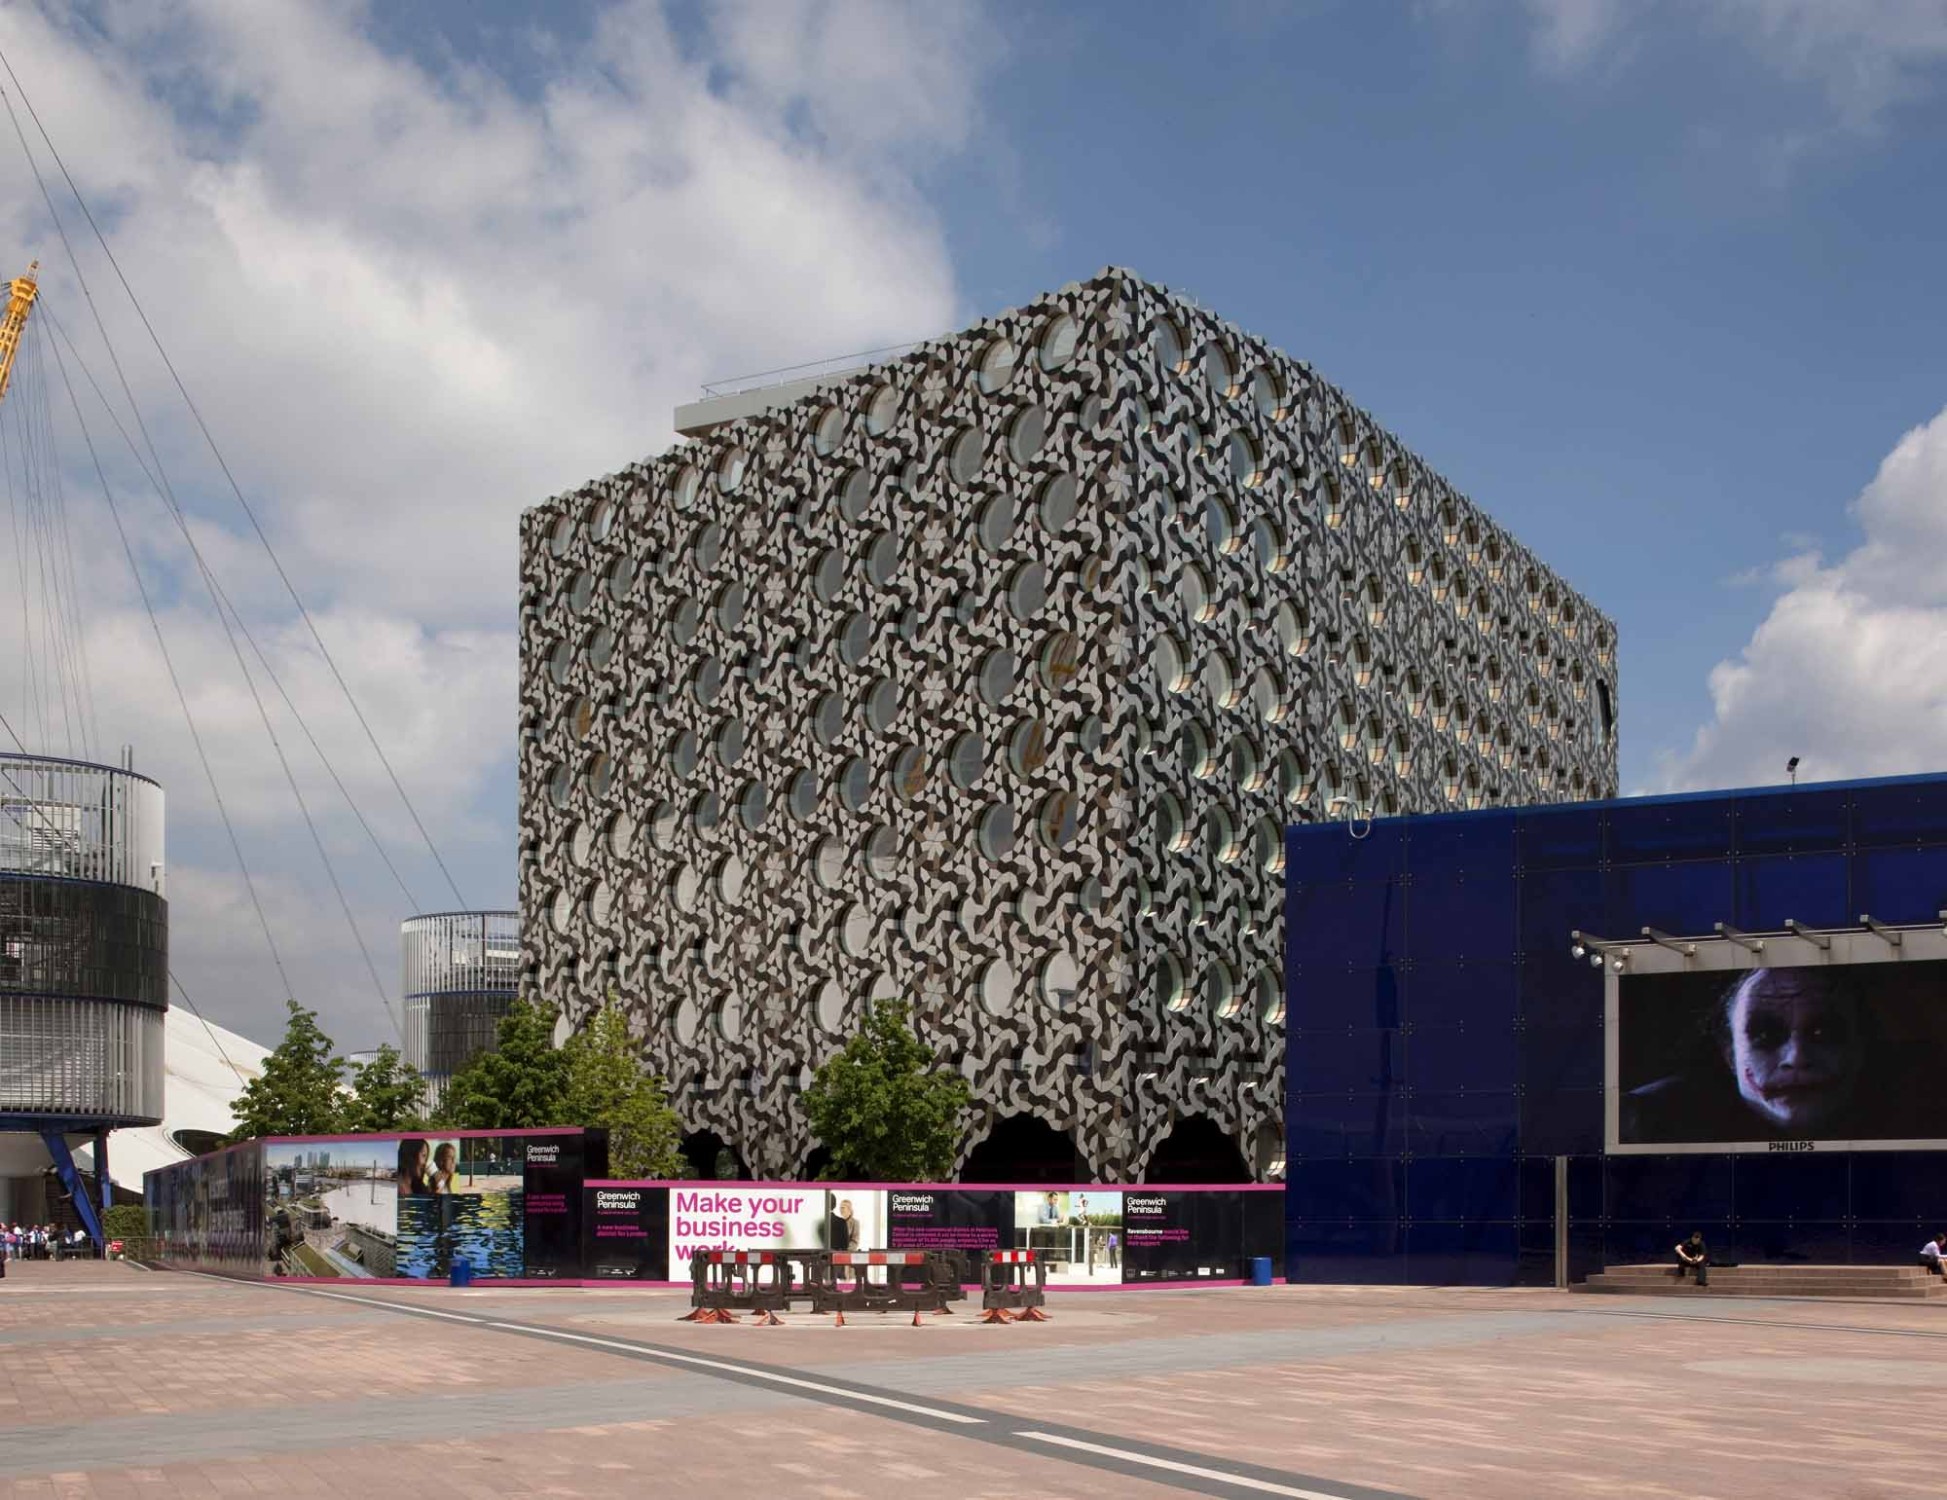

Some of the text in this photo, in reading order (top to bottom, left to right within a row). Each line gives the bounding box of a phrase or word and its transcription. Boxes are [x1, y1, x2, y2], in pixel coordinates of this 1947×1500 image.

[526, 1144, 560, 1154] Greenwich
[1768, 1141, 1815, 1151] PHILIPS
[526, 1153, 556, 1163] Peninsula
[596, 1190, 641, 1200] Greenwich
[892, 1194, 934, 1203] Greenwich
[597, 1199, 636, 1209] Peninsula
[676, 1192, 804, 1219] Make your
[1126, 1196, 1167, 1206] Greenwich
[892, 1202, 930, 1212] Peninsula
[1127, 1205, 1163, 1214] Peninsula
[676, 1215, 785, 1237] business
